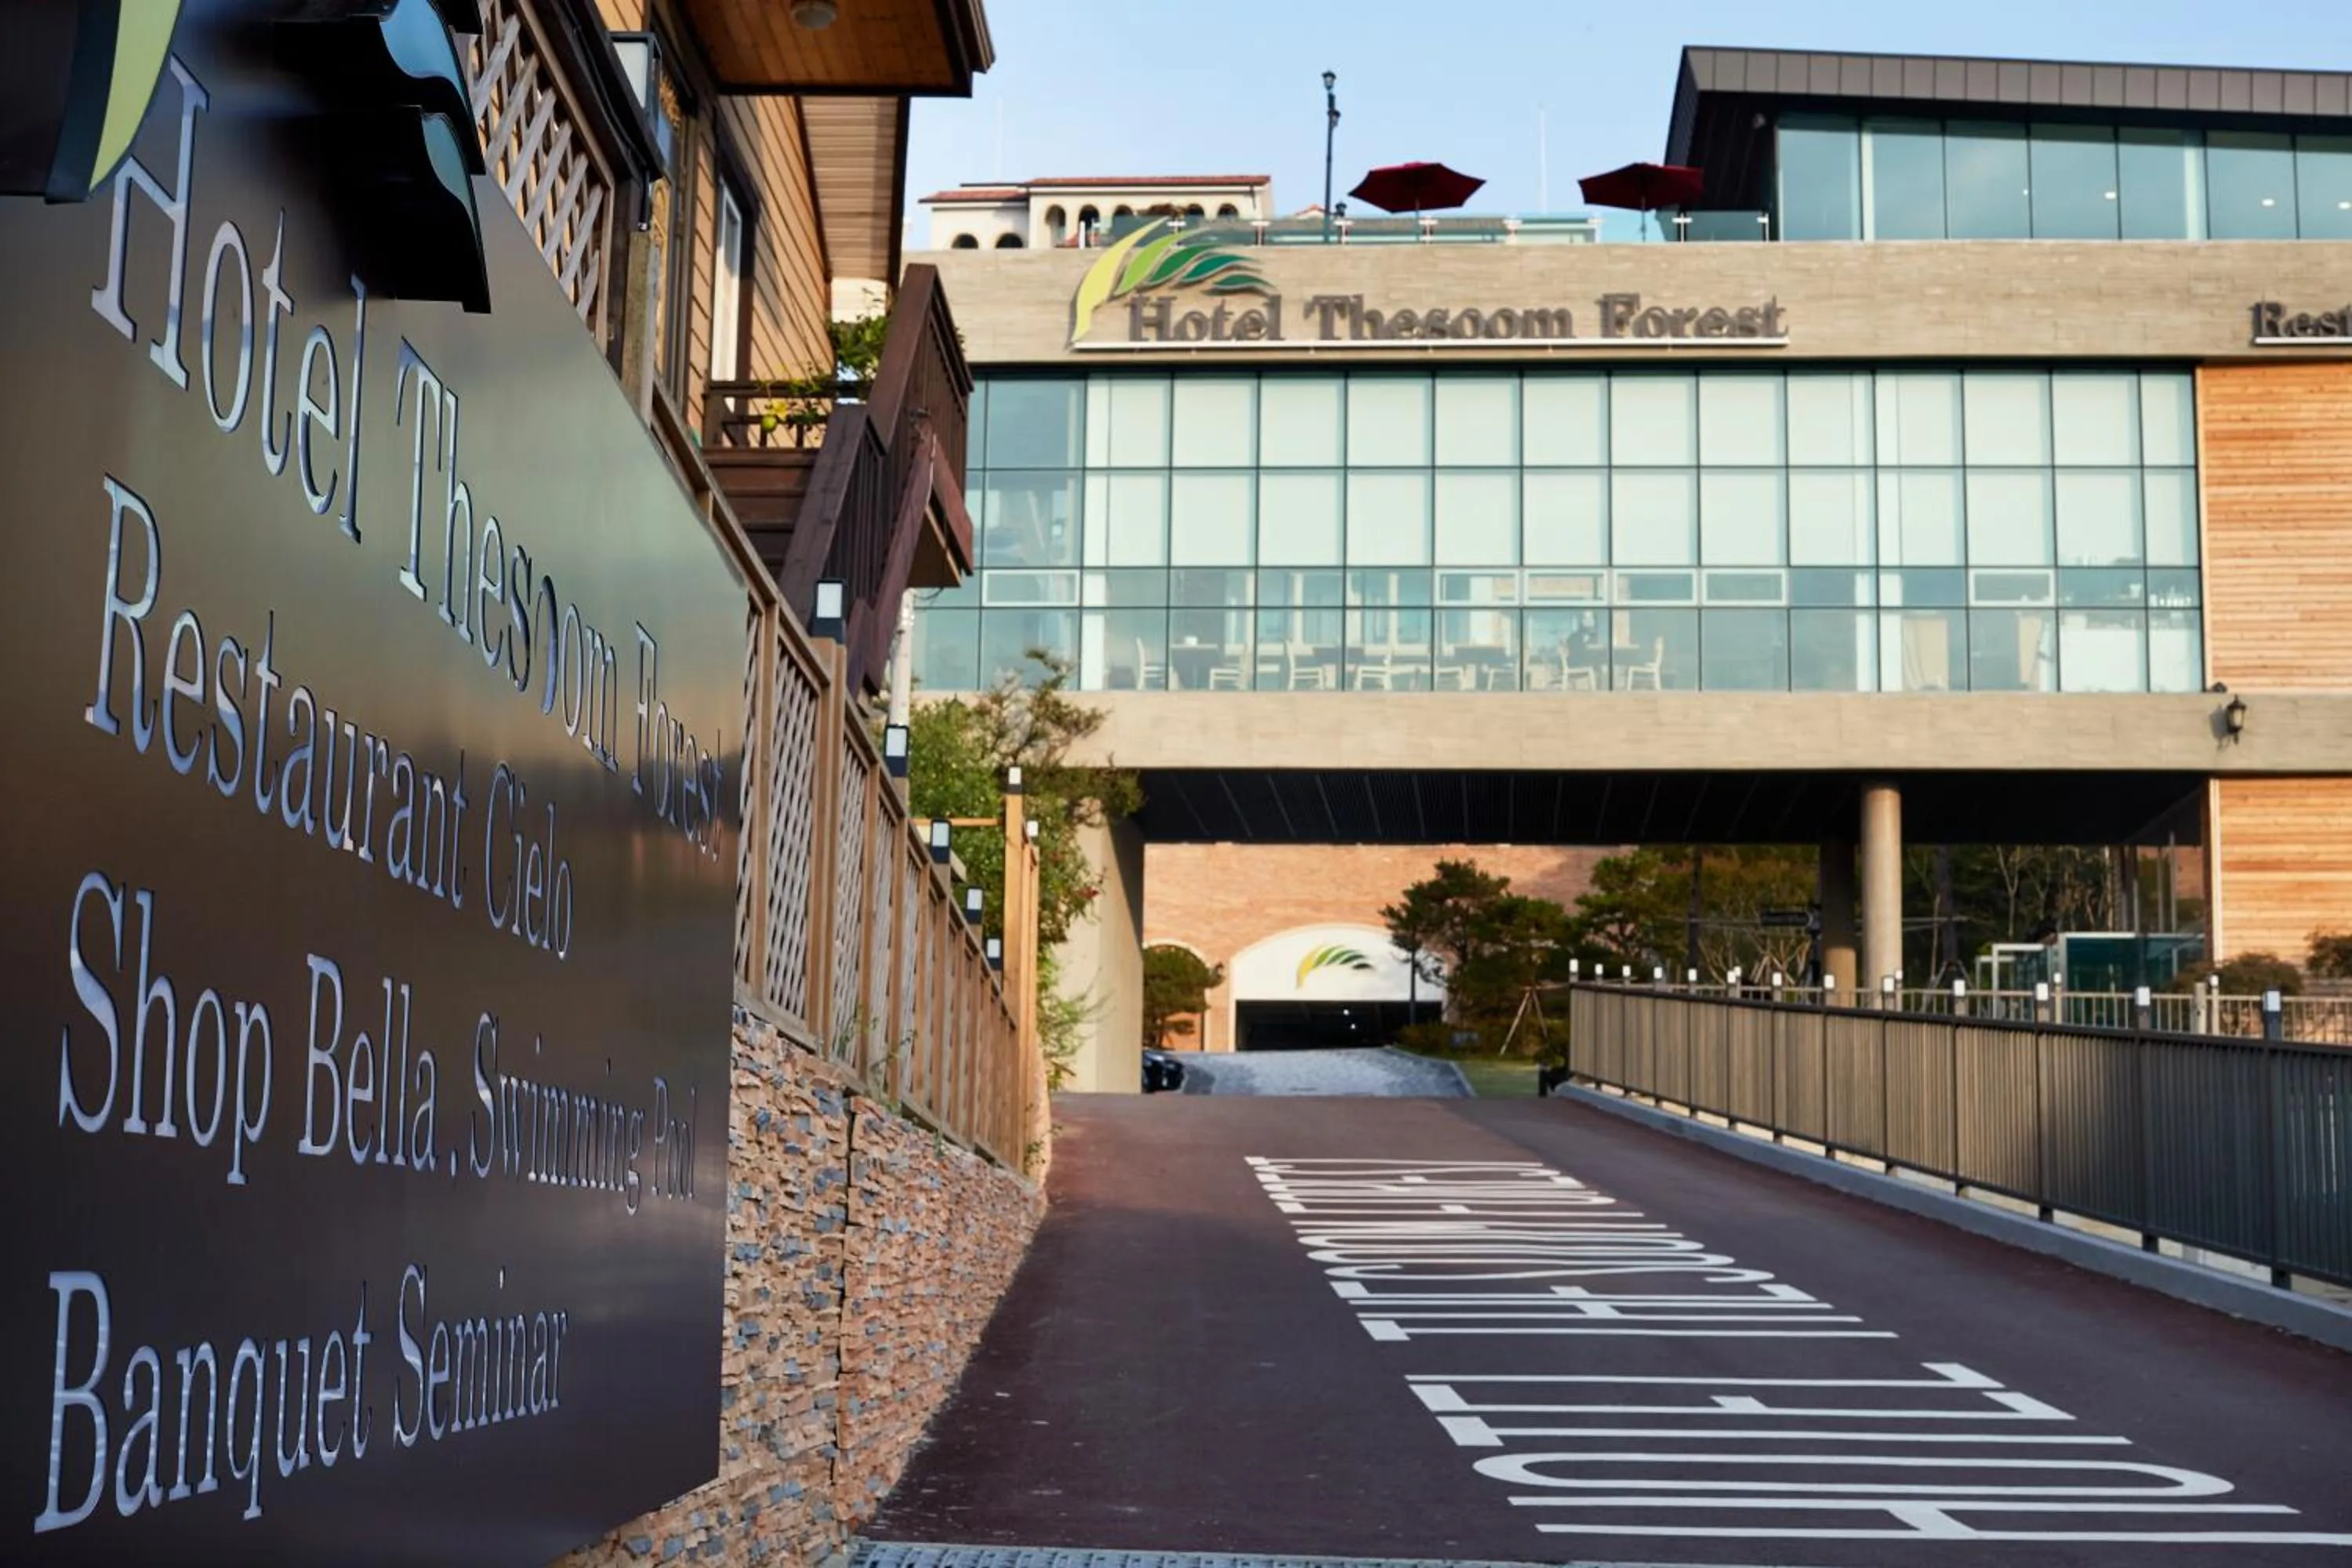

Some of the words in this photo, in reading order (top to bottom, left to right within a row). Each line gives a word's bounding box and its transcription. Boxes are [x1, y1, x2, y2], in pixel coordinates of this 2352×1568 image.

[90, 52, 366, 544] Hotel
[632, 620, 724, 862] Forest
[1126, 293, 1284, 341] Hotel
[1304, 293, 1576, 340] Thesoom
[1595, 292, 1788, 338] Forest
[85, 472, 469, 908] Restaurant
[485, 760, 572, 960] Cielo
[59, 871, 273, 1185] Shop
[653, 1076, 696, 1201] Pool
[34, 1270, 373, 1532] Banquet
[393, 1264, 568, 1448] Seminar
[1404, 1363, 2352, 1545] HOTEL
